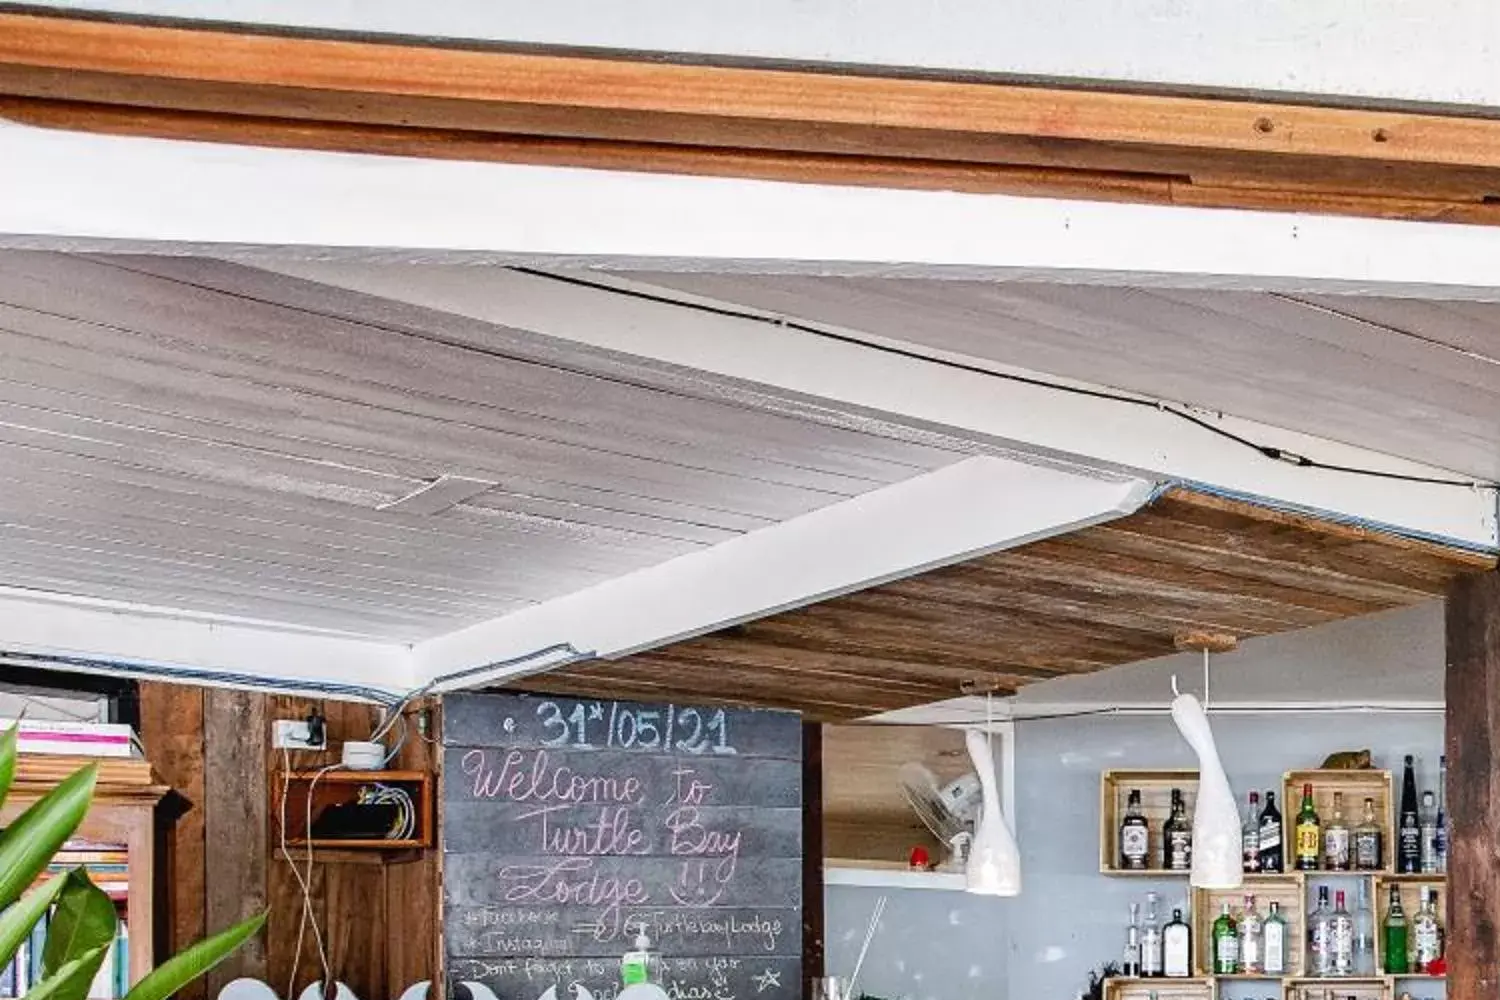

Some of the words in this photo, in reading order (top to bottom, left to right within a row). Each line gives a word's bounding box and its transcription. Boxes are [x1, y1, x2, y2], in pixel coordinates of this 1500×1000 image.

[461, 749, 643, 805] Welcome
[515, 804, 650, 855] Turtle
[665, 806, 742, 883] Bay
[499, 856, 650, 942] Lodge
